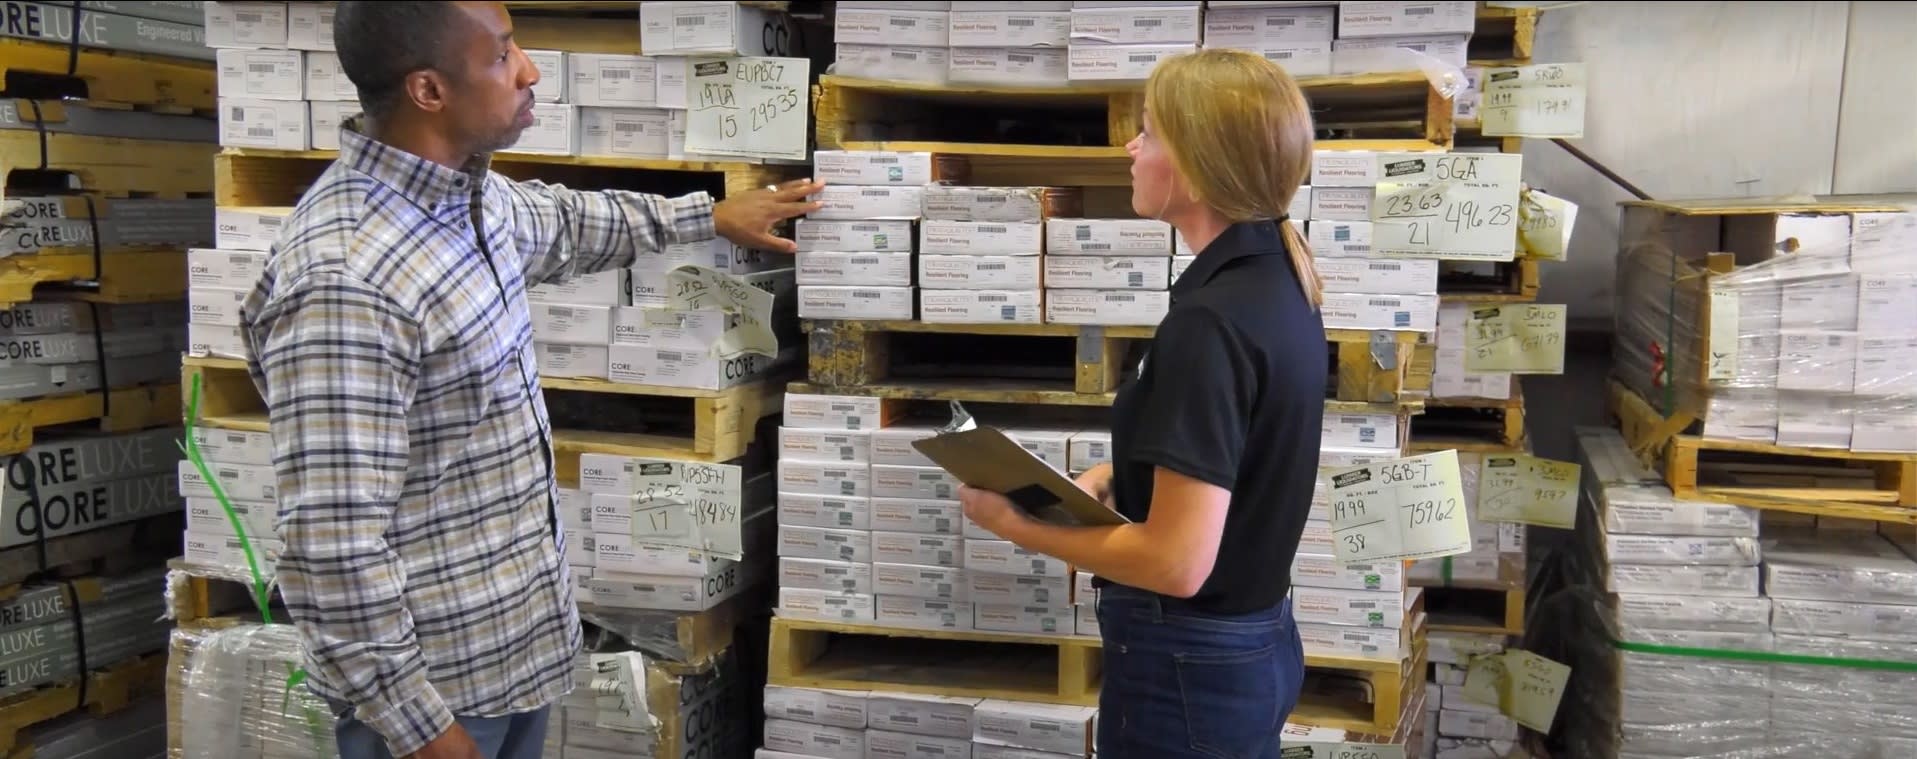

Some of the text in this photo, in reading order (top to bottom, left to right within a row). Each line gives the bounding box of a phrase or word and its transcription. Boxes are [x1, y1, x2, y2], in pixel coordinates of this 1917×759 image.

[136, 21, 192, 41] Engineered
[718, 114, 737, 140] 15
[1436, 157, 1477, 180] 5GA
[1408, 222, 1429, 246] 21
[726, 356, 754, 380] CORE
[583, 467, 602, 475] CORE
[649, 510, 668, 531] 17
[1344, 534, 1365, 553] 38
[707, 569, 735, 597] CORE
